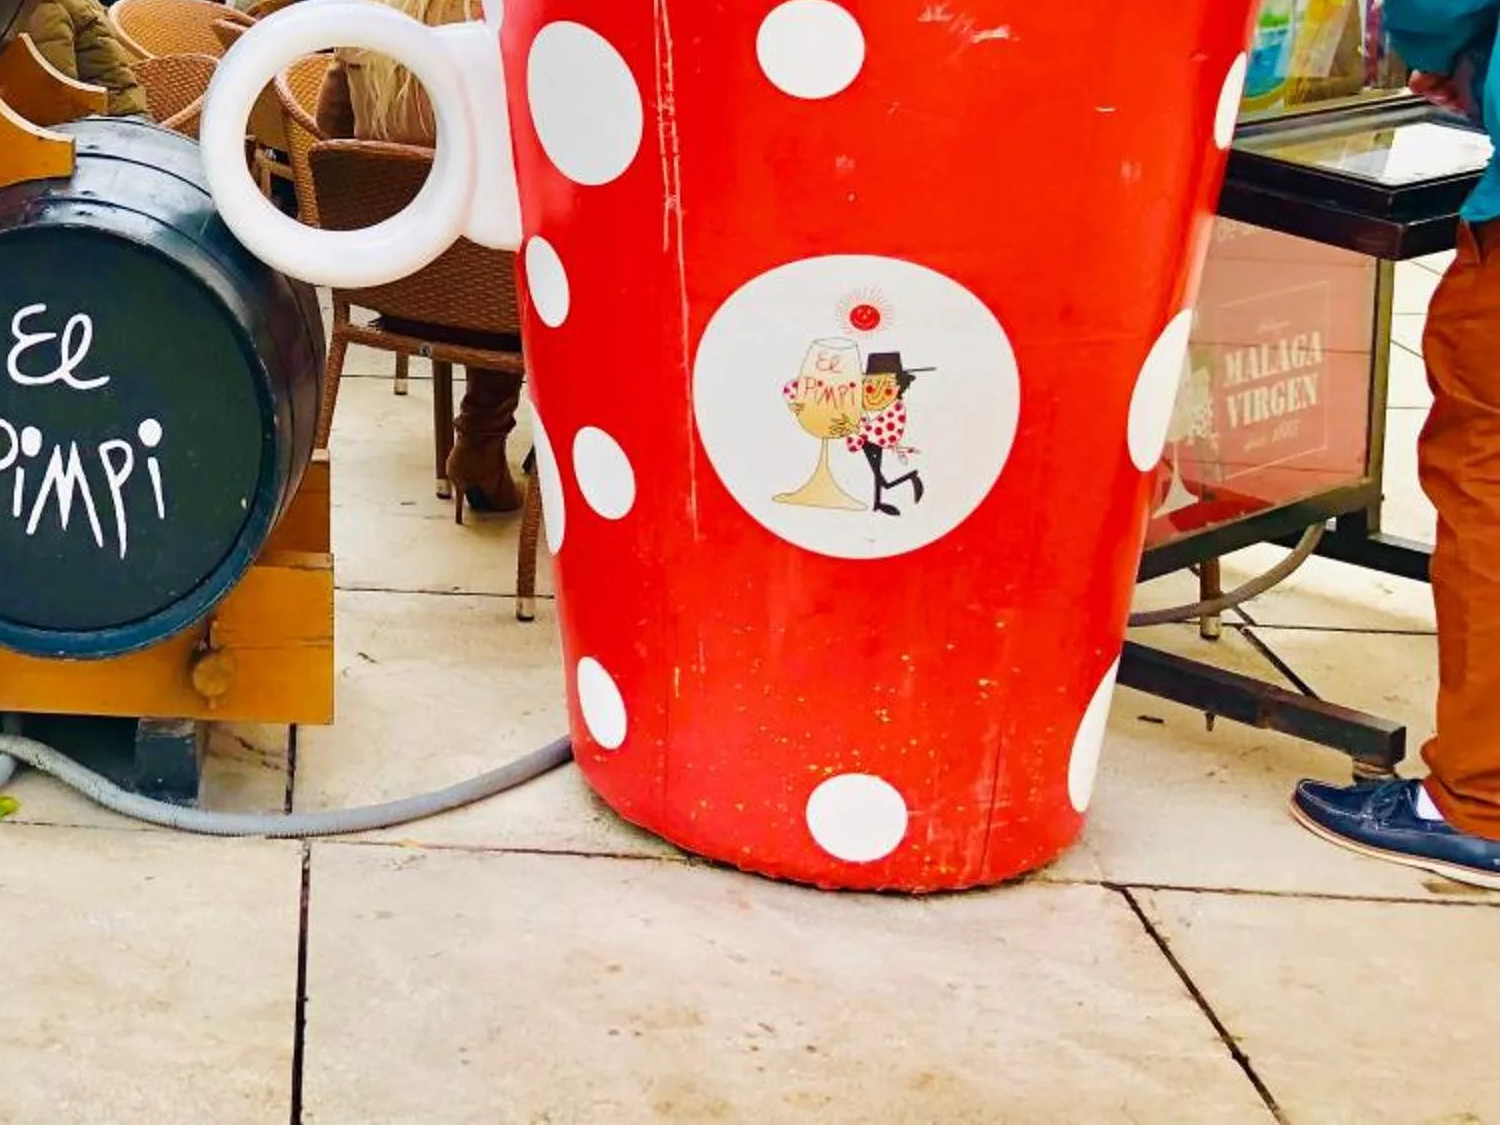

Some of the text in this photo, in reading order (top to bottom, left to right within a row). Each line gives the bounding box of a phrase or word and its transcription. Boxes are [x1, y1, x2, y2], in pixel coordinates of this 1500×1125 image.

[7, 303, 110, 390] El
[1222, 329, 1324, 388] MALAGA
[1225, 372, 1320, 429] VIRGEN
